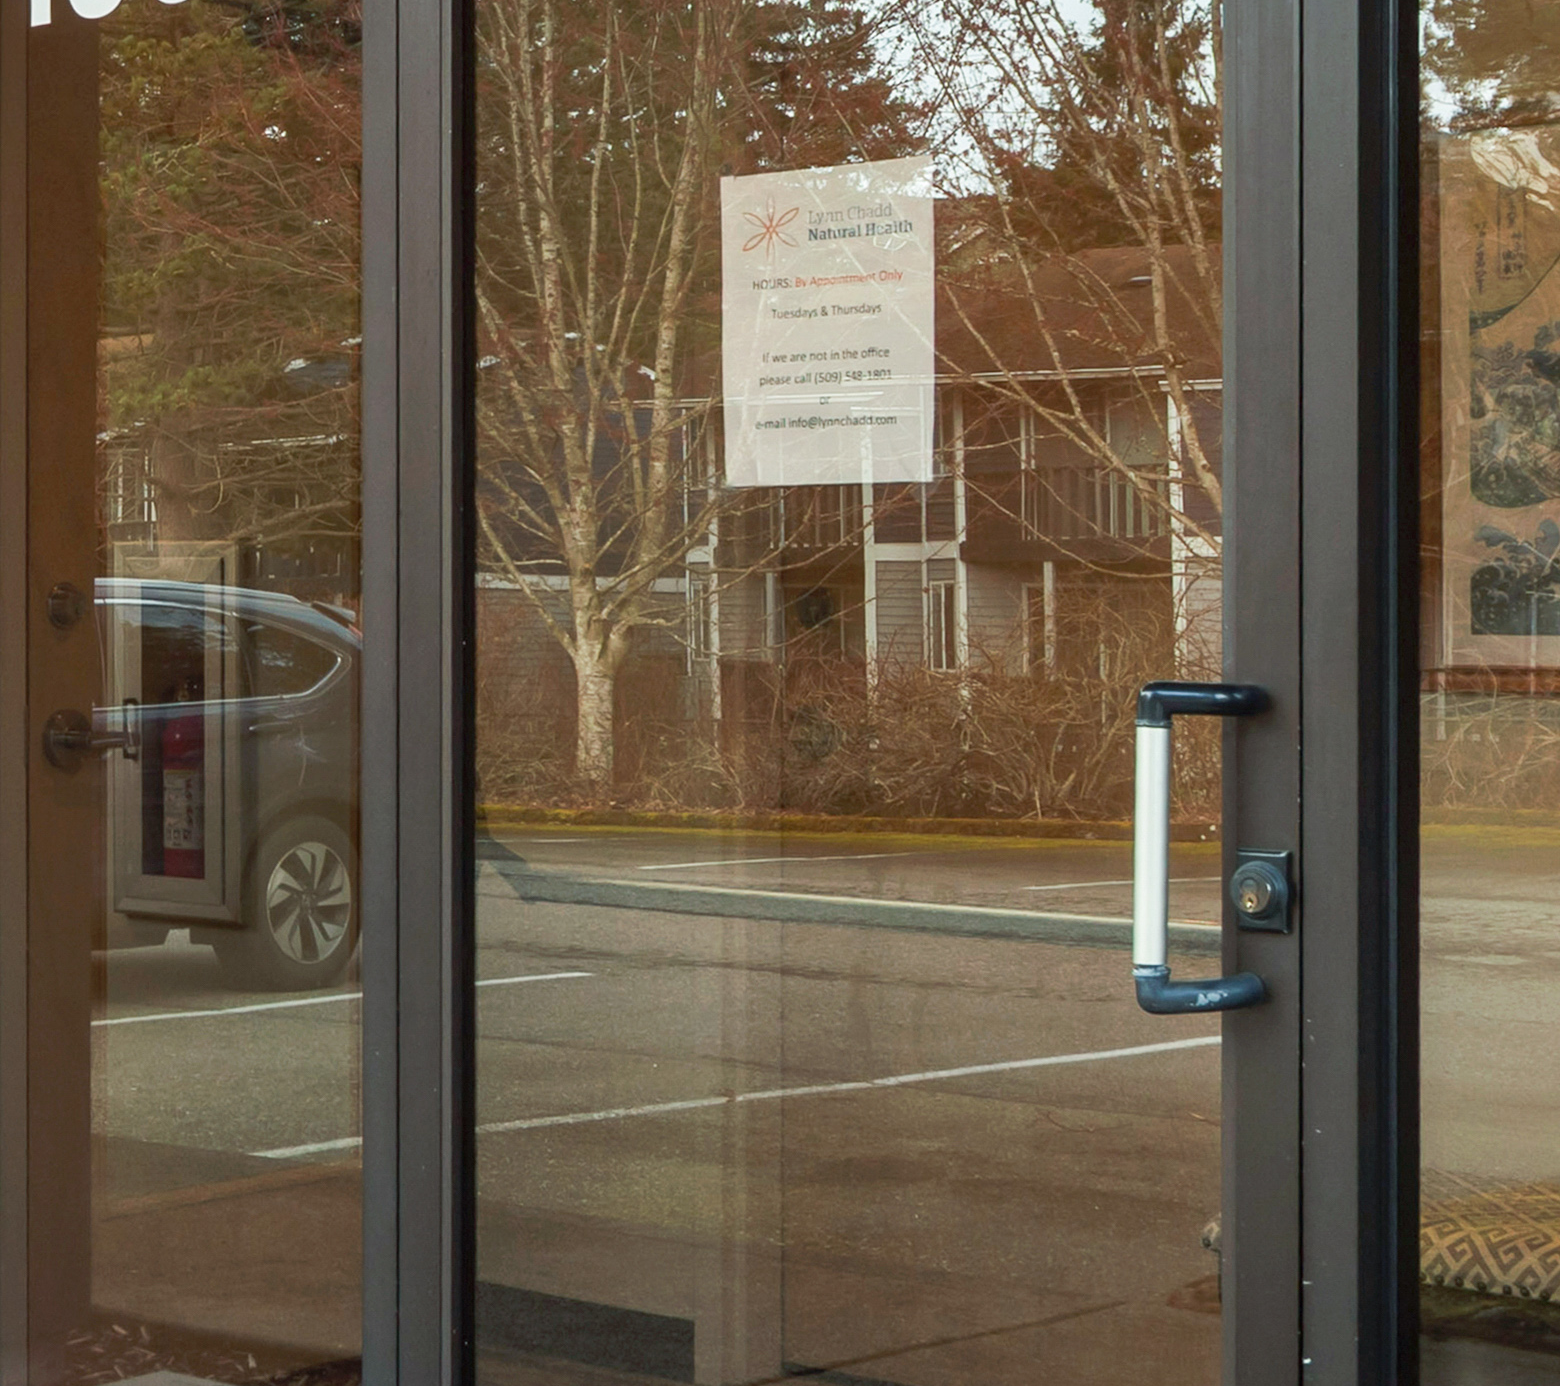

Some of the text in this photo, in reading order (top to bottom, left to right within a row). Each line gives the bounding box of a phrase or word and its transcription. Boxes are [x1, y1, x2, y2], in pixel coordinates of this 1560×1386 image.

[808, 203, 892, 225] Lynn Chadd
[808, 220, 913, 241] Natural Health
[752, 269, 904, 290] HOURS: By Appointment Only
[772, 303, 882, 320] Tuesdays & Thursdays
[762, 346, 890, 363] If we are not in the office
[759, 374, 791, 387] please
[794, 372, 812, 384] call
[814, 371, 842, 385] (509)
[819, 396, 831, 405] or
[755, 415, 898, 430] e-mail info@lynnchadd.com
